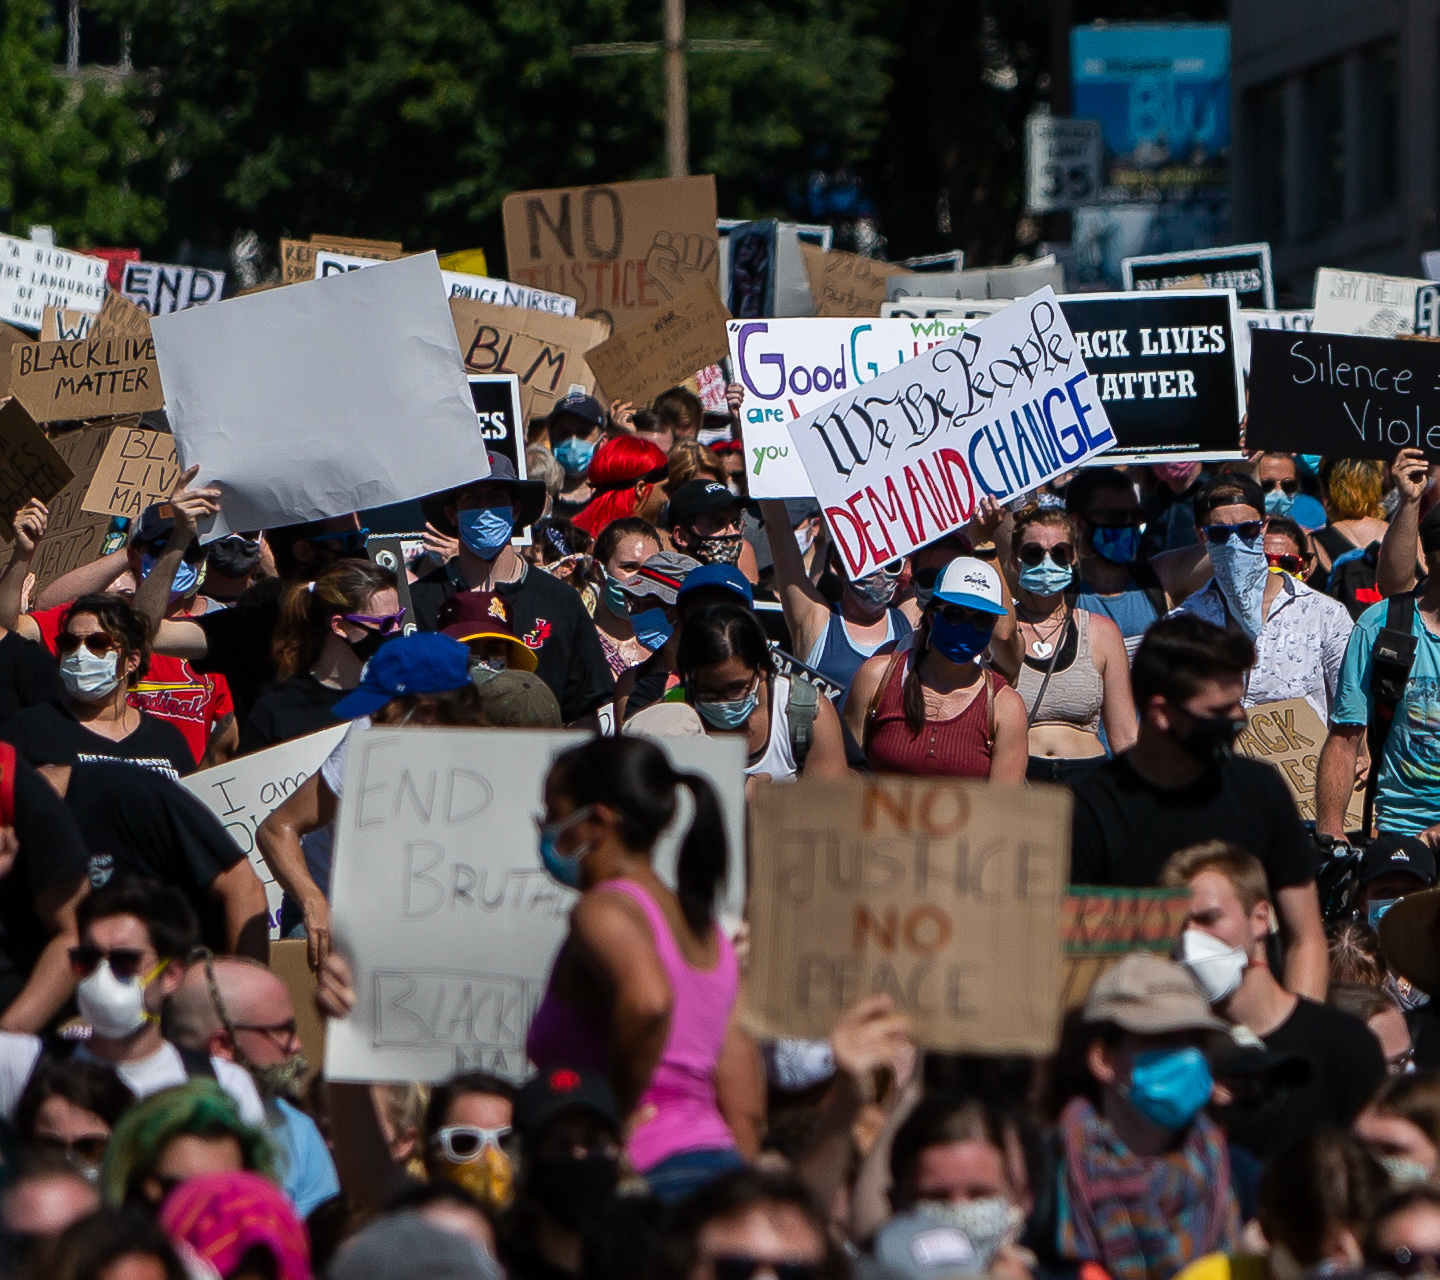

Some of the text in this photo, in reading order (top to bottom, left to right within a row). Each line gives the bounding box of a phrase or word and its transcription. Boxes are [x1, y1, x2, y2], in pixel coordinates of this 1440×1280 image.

[1037, 163, 1092, 200] 35
[525, 186, 625, 262] NO
[125, 265, 217, 303] END
[19, 336, 157, 376] BLACK LIVE
[464, 324, 566, 392] BLM
[931, 299, 1076, 429] People
[1074, 324, 1227, 359] ACK LIVES
[1289, 339, 1413, 395] Silence
[54, 366, 150, 401] MATTER
[746, 405, 784, 424] are
[119, 428, 179, 466] BLA
[752, 443, 789, 476] you
[115, 459, 179, 493] LIV
[823, 370, 1114, 578] DEMAND CHANGE
[1236, 707, 1316, 760] ACK
[211, 776, 247, 817] I
[354, 736, 495, 830] END
[860, 783, 973, 840] NO
[775, 830, 1055, 905] JUSTICE
[851, 903, 954, 955] NO
[802, 960, 971, 1018] PEACE
